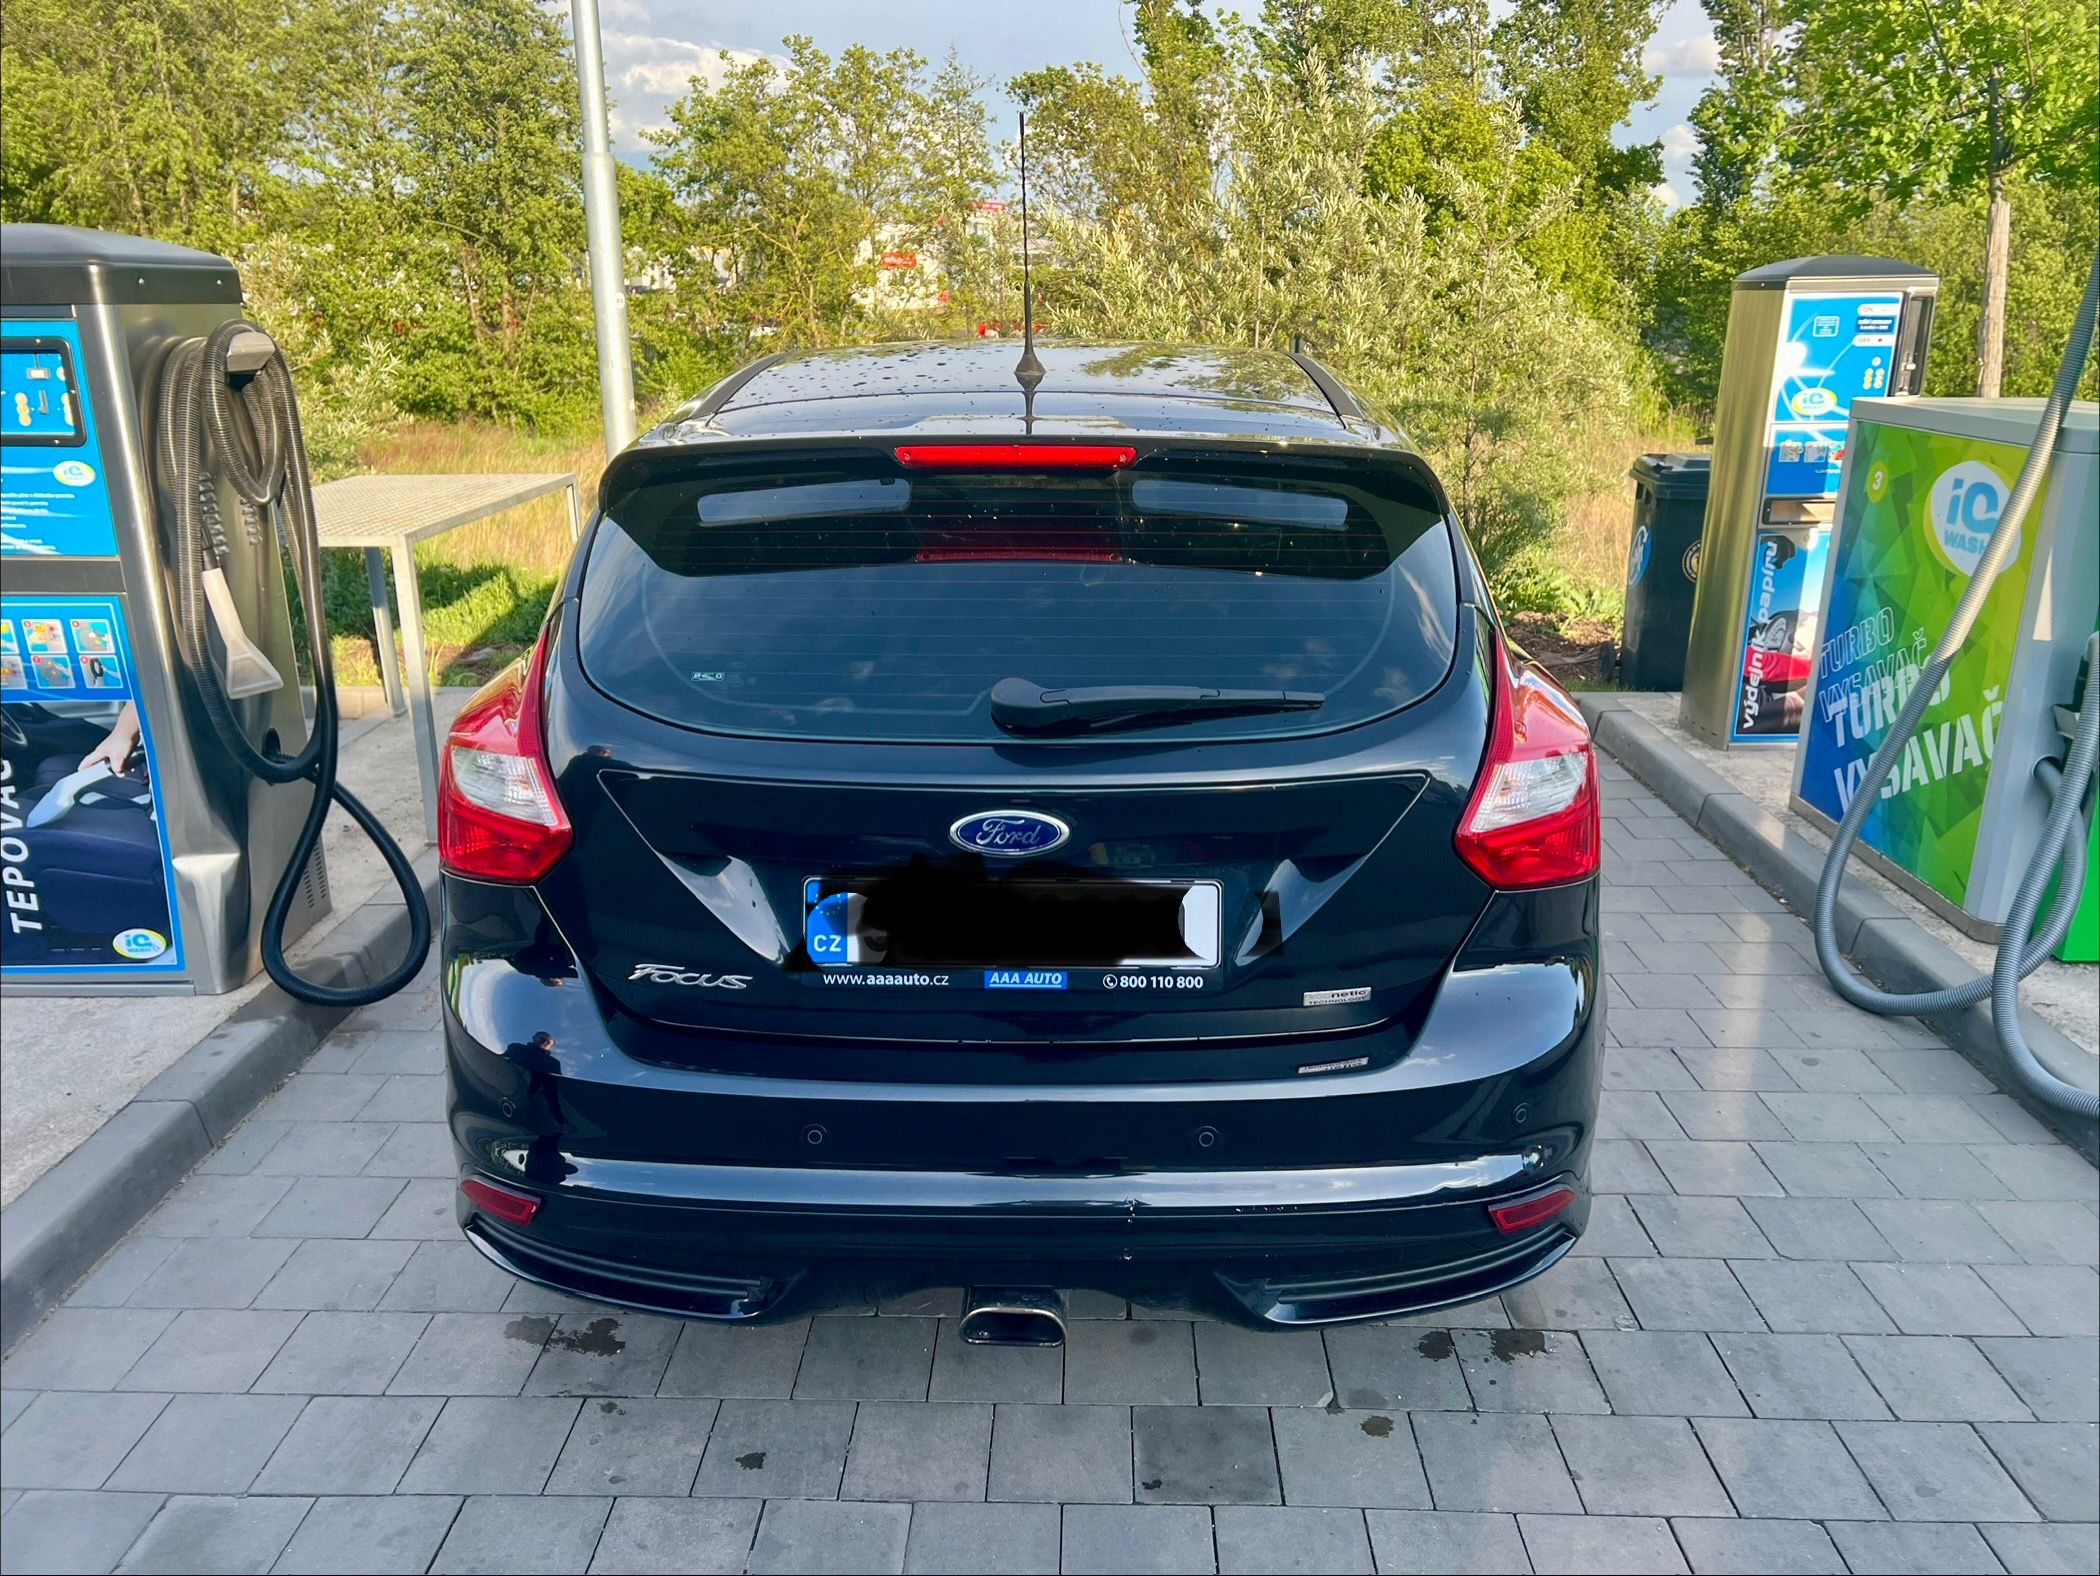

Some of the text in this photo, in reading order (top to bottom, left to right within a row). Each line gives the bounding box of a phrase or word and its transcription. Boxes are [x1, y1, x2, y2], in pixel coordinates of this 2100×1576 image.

[1872, 470, 1884, 491] 3
[1946, 478, 1999, 534] iQ
[1743, 541, 1778, 728] výdejník papíru
[1820, 606, 1895, 679] TURBO
[975, 818, 1042, 845] Ford
[813, 934, 842, 953] CZ
[823, 973, 950, 986] www.aaaauto.cz
[990, 972, 1063, 985] AAA AUTO
[1119, 975, 1204, 989] 800 110 800
